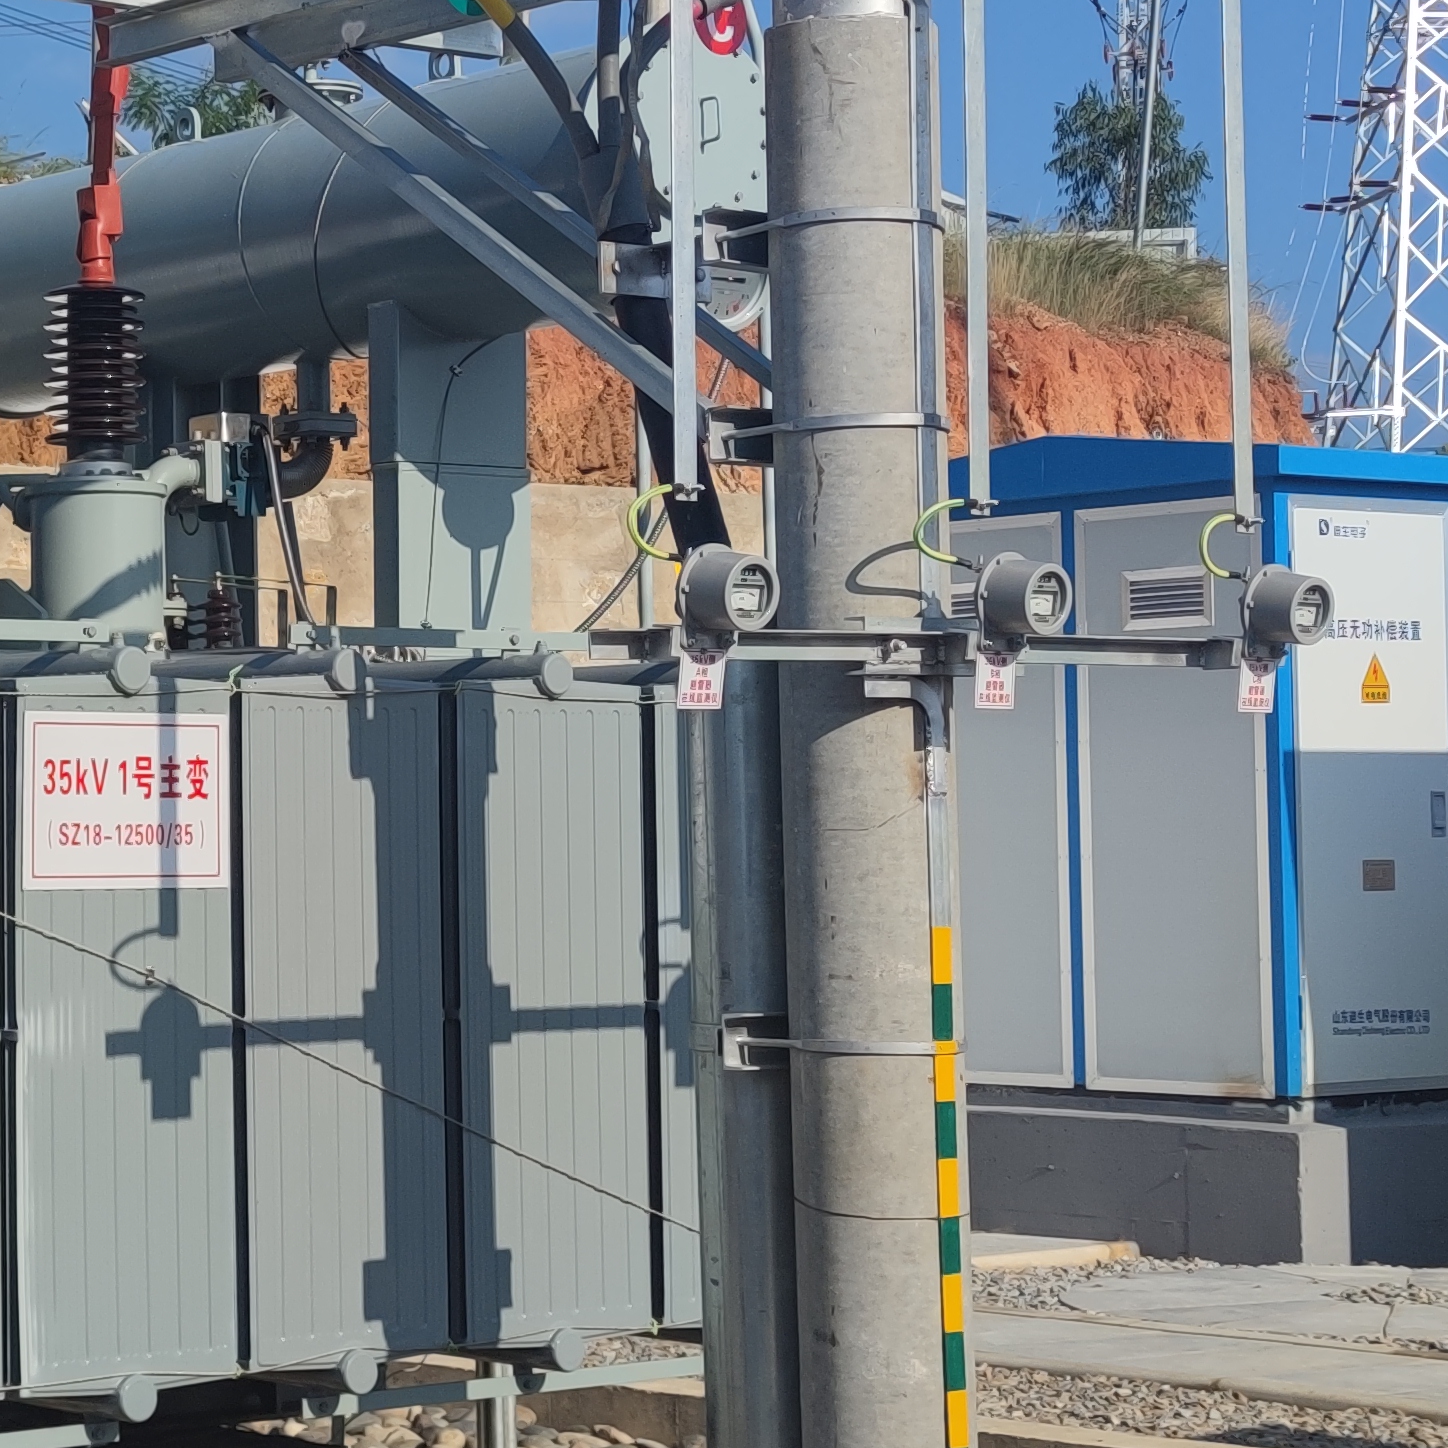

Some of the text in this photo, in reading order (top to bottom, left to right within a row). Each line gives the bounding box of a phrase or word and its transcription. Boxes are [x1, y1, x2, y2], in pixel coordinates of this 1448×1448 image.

[1324, 619, 1422, 642] 高压无功补偿装置
[43, 755, 209, 800] 35kV 1号主变
